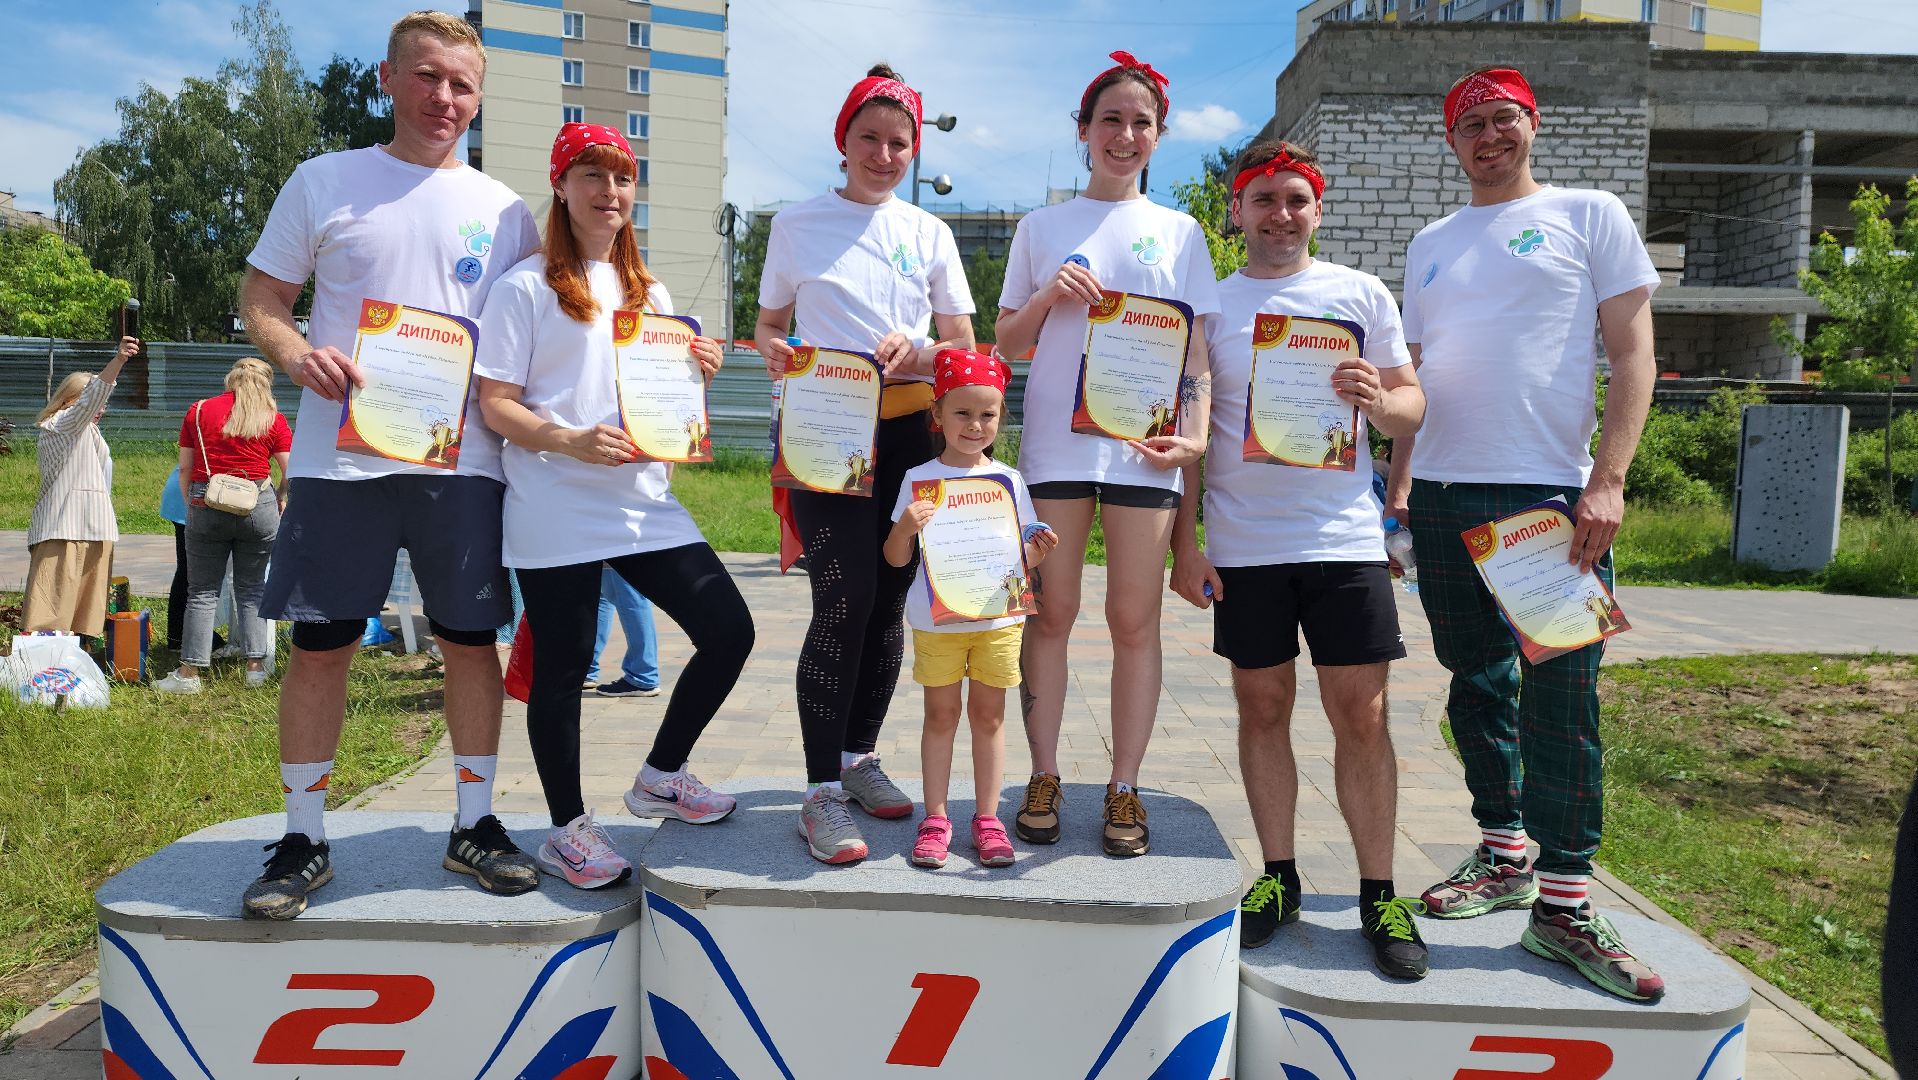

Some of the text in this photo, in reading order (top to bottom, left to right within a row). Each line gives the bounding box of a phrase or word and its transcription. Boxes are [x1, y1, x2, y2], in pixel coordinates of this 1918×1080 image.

[1121, 310, 1181, 331] ДИПЛОМ
[396, 323, 464, 347] ДИПЛОМ
[642, 330, 691, 346] ДИПЛОМ
[1287, 333, 1350, 351] ДИПЛОМ
[814, 364, 872, 383] ДИПЛОМ
[947, 489, 1003, 509] ДИПЛОМ
[1502, 515, 1561, 550] ДИПЛОМ
[252, 973, 435, 1067] 2
[886, 972, 981, 1068] 1
